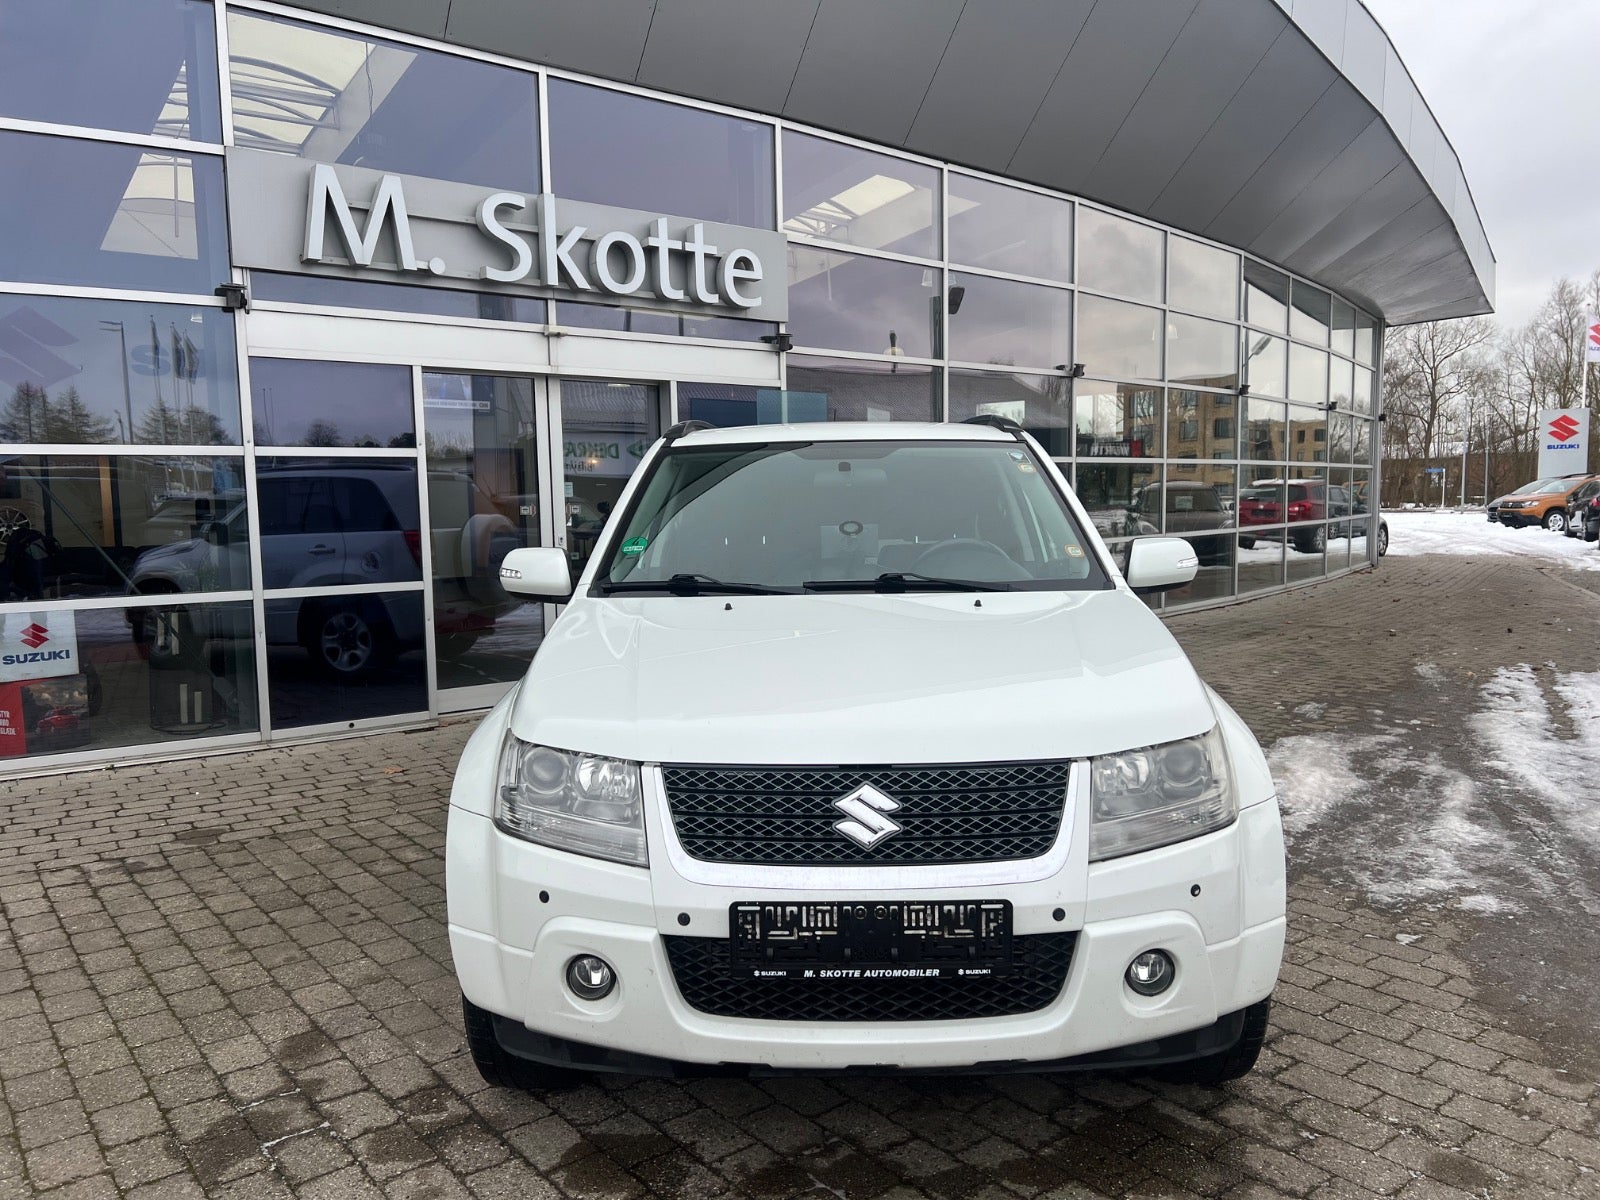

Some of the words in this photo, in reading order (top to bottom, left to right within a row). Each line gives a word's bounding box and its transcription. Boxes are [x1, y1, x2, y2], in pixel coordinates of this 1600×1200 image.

[301, 163, 446, 276] M.
[475, 192, 763, 309] Skotte
[2, 650, 71, 665] SUZUKI
[804, 969, 816, 977] M.
[820, 969, 861, 977] SKOTTE
[864, 969, 940, 977] AUTOMOBILER
